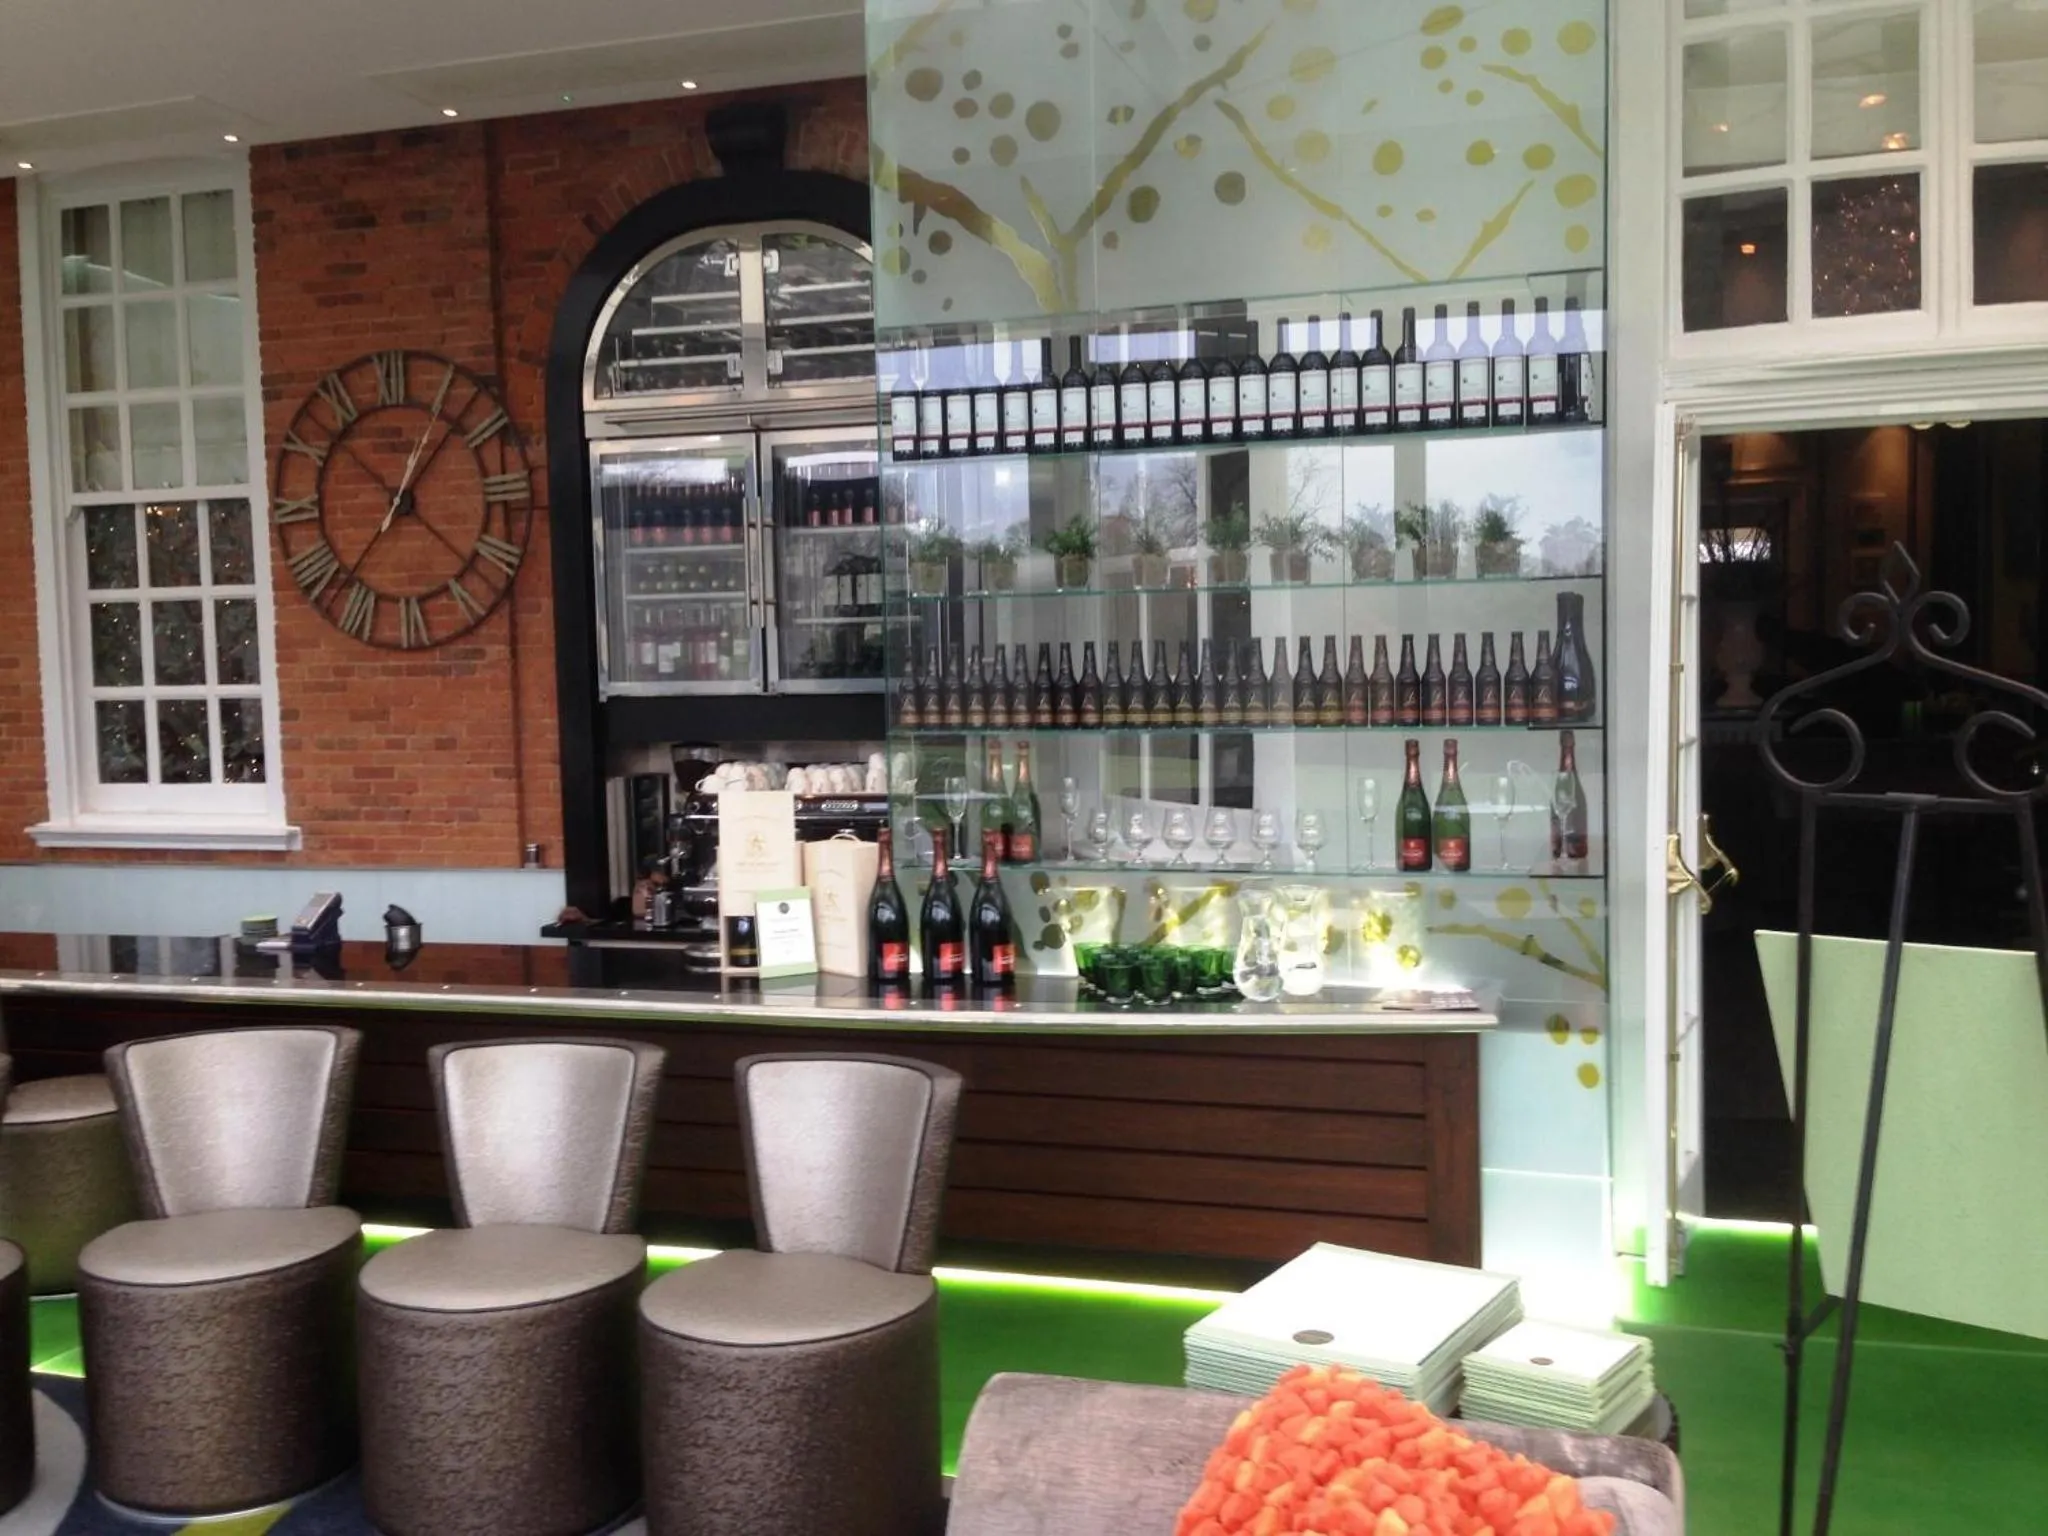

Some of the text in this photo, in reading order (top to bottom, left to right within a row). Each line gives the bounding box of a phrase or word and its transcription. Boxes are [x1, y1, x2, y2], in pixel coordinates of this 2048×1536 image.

[317, 373, 358, 427] XI
[372, 350, 404, 405] XII
[274, 494, 318, 523] IX
[484, 473, 530, 502] III
[288, 541, 339, 600] VIII
[339, 583, 376, 641] VII
[400, 598, 432, 648] VI
